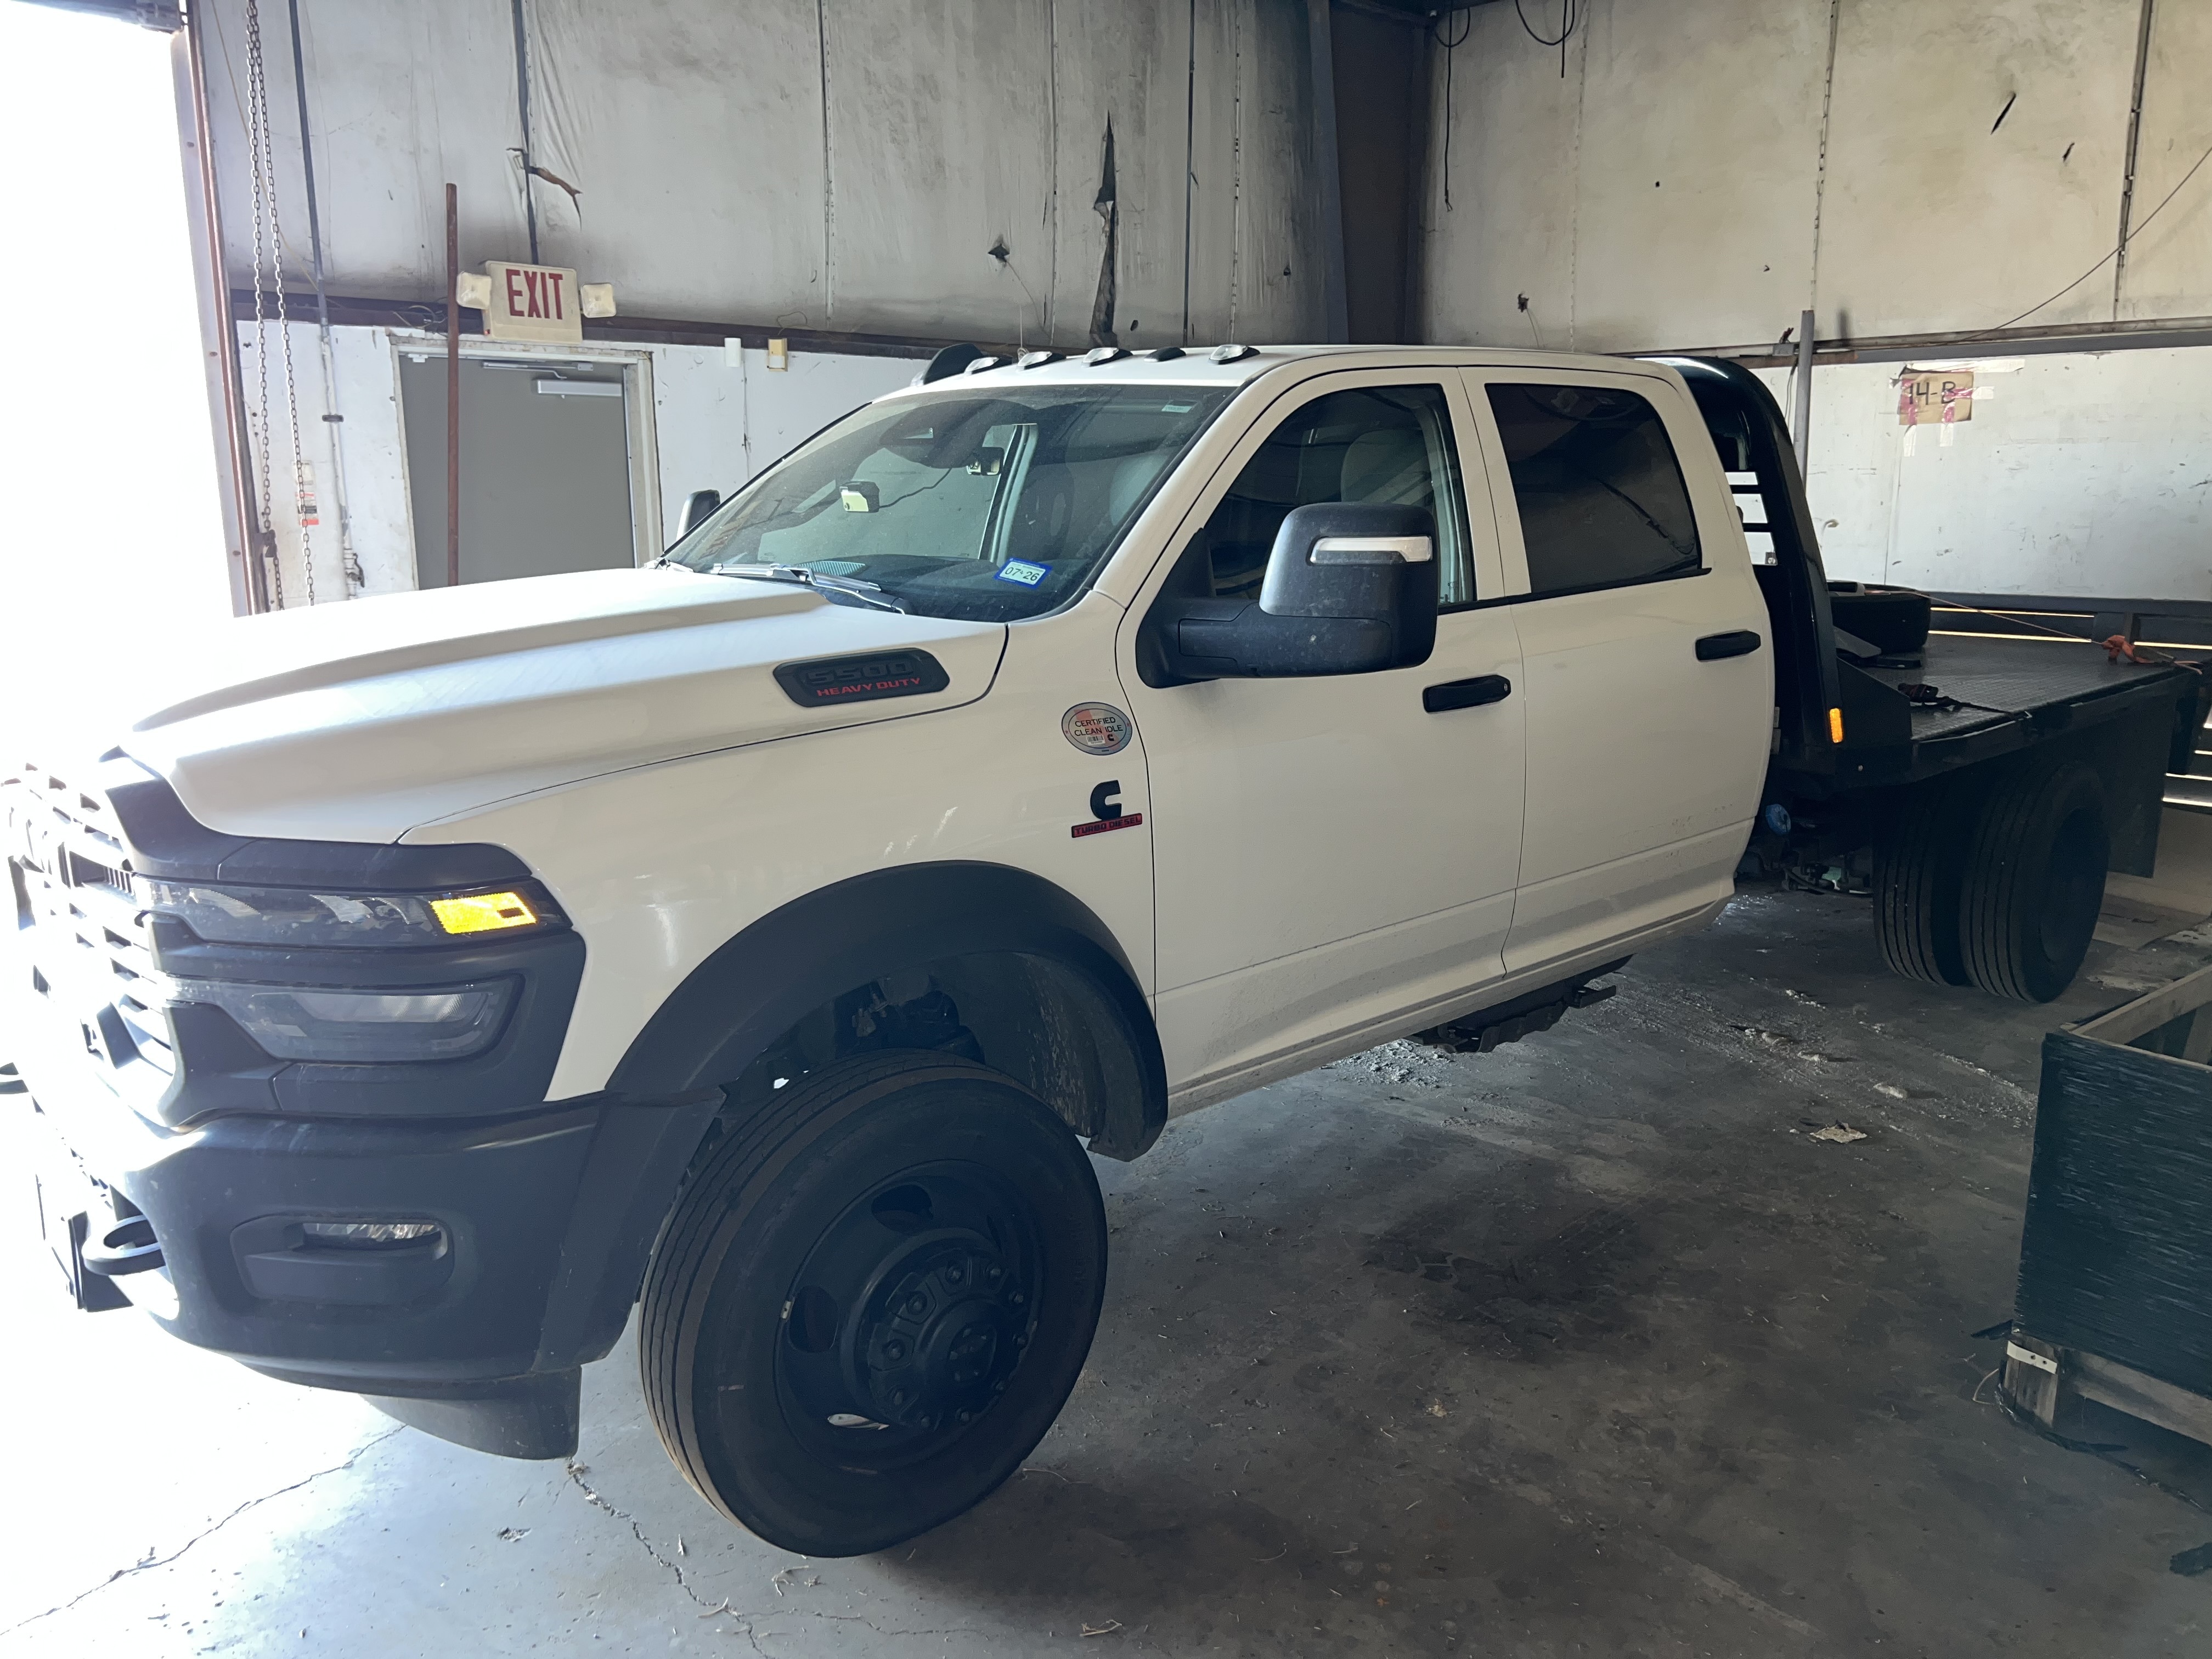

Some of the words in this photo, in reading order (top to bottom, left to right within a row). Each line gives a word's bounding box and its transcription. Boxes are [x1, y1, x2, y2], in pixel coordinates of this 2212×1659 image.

[506, 268, 563, 320] EXIT
[807, 661, 914, 685] 5500
[816, 684, 872, 696] HEAVY
[876, 678, 921, 690] DUTY
[1074, 727, 1102, 736] CLEAN
[1105, 725, 1123, 733] IDLE
[1075, 717, 1116, 727] CERTIFIED
[1075, 822, 1107, 834] TURBO
[1109, 816, 1141, 828] DIESEL
